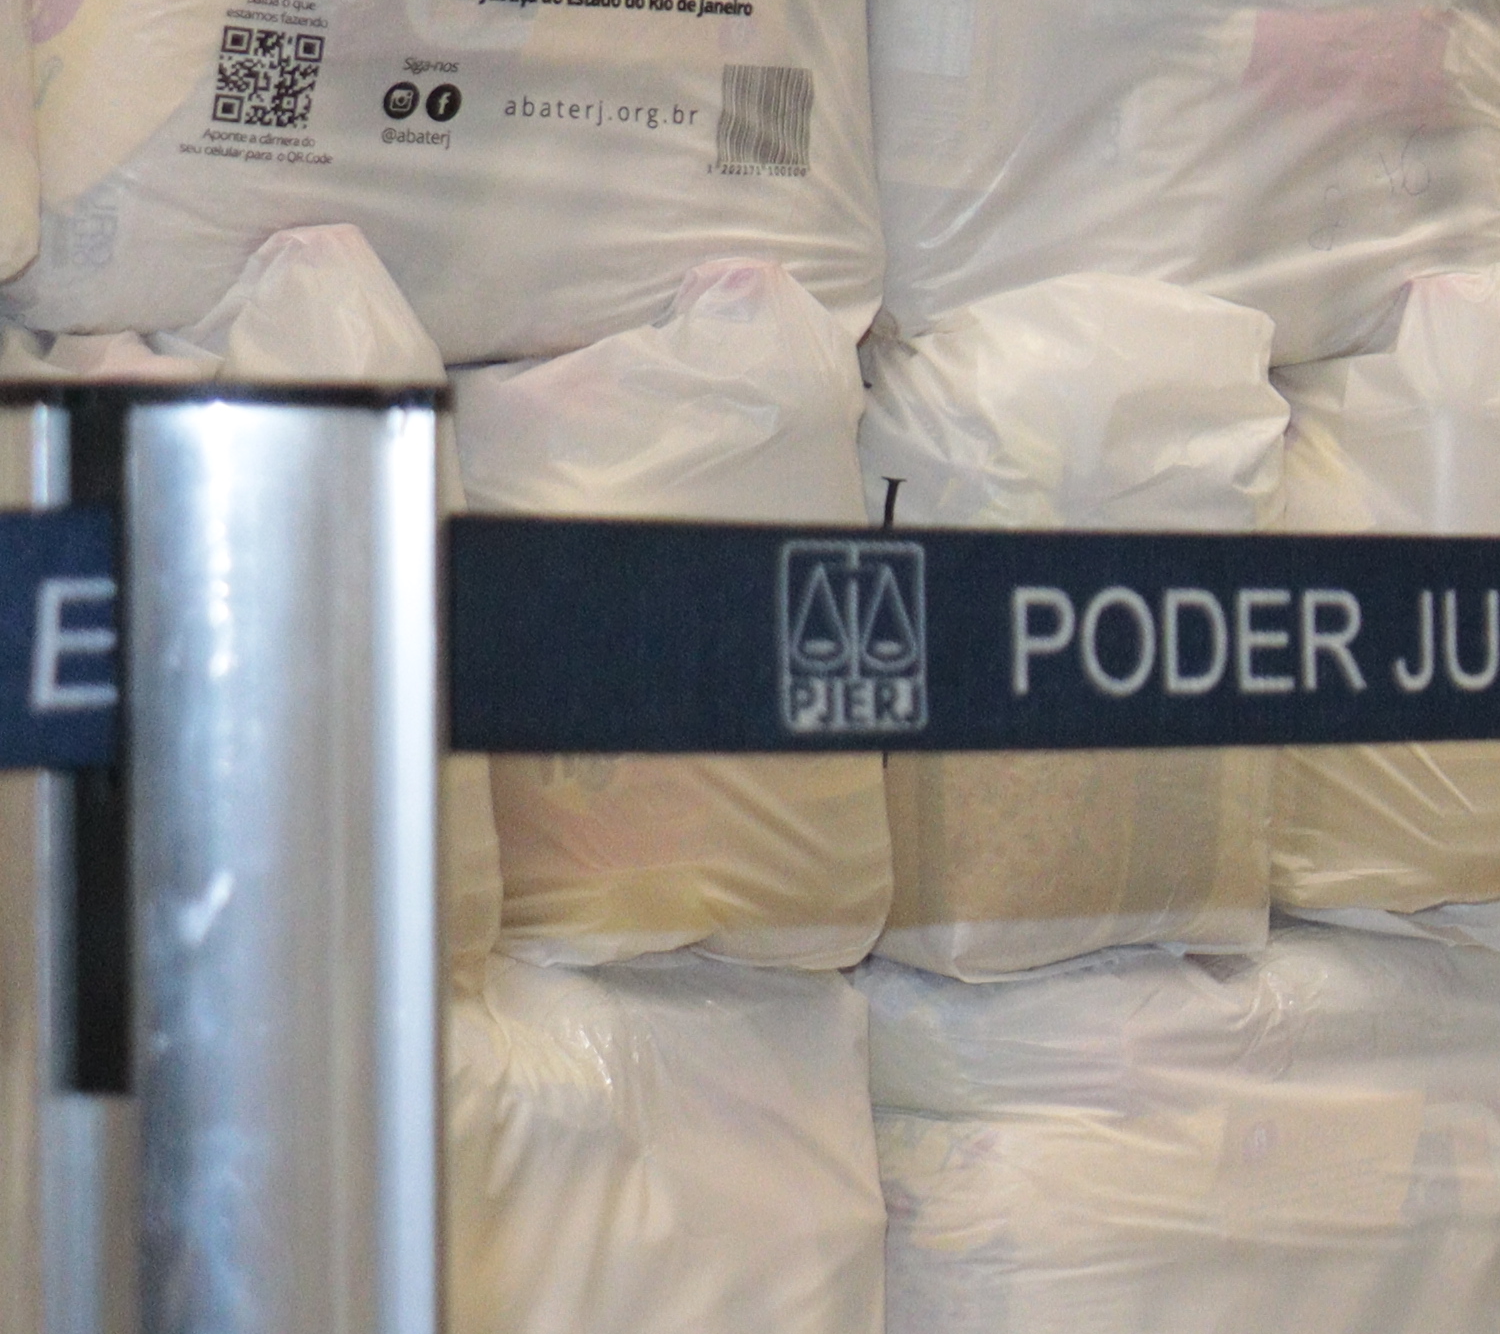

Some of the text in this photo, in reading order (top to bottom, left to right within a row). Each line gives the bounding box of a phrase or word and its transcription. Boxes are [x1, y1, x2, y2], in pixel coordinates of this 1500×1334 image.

[504, 95, 700, 129] abaterj.org.br
[381, 127, 451, 149] @abaterj
[1011, 586, 1368, 698] PODER
